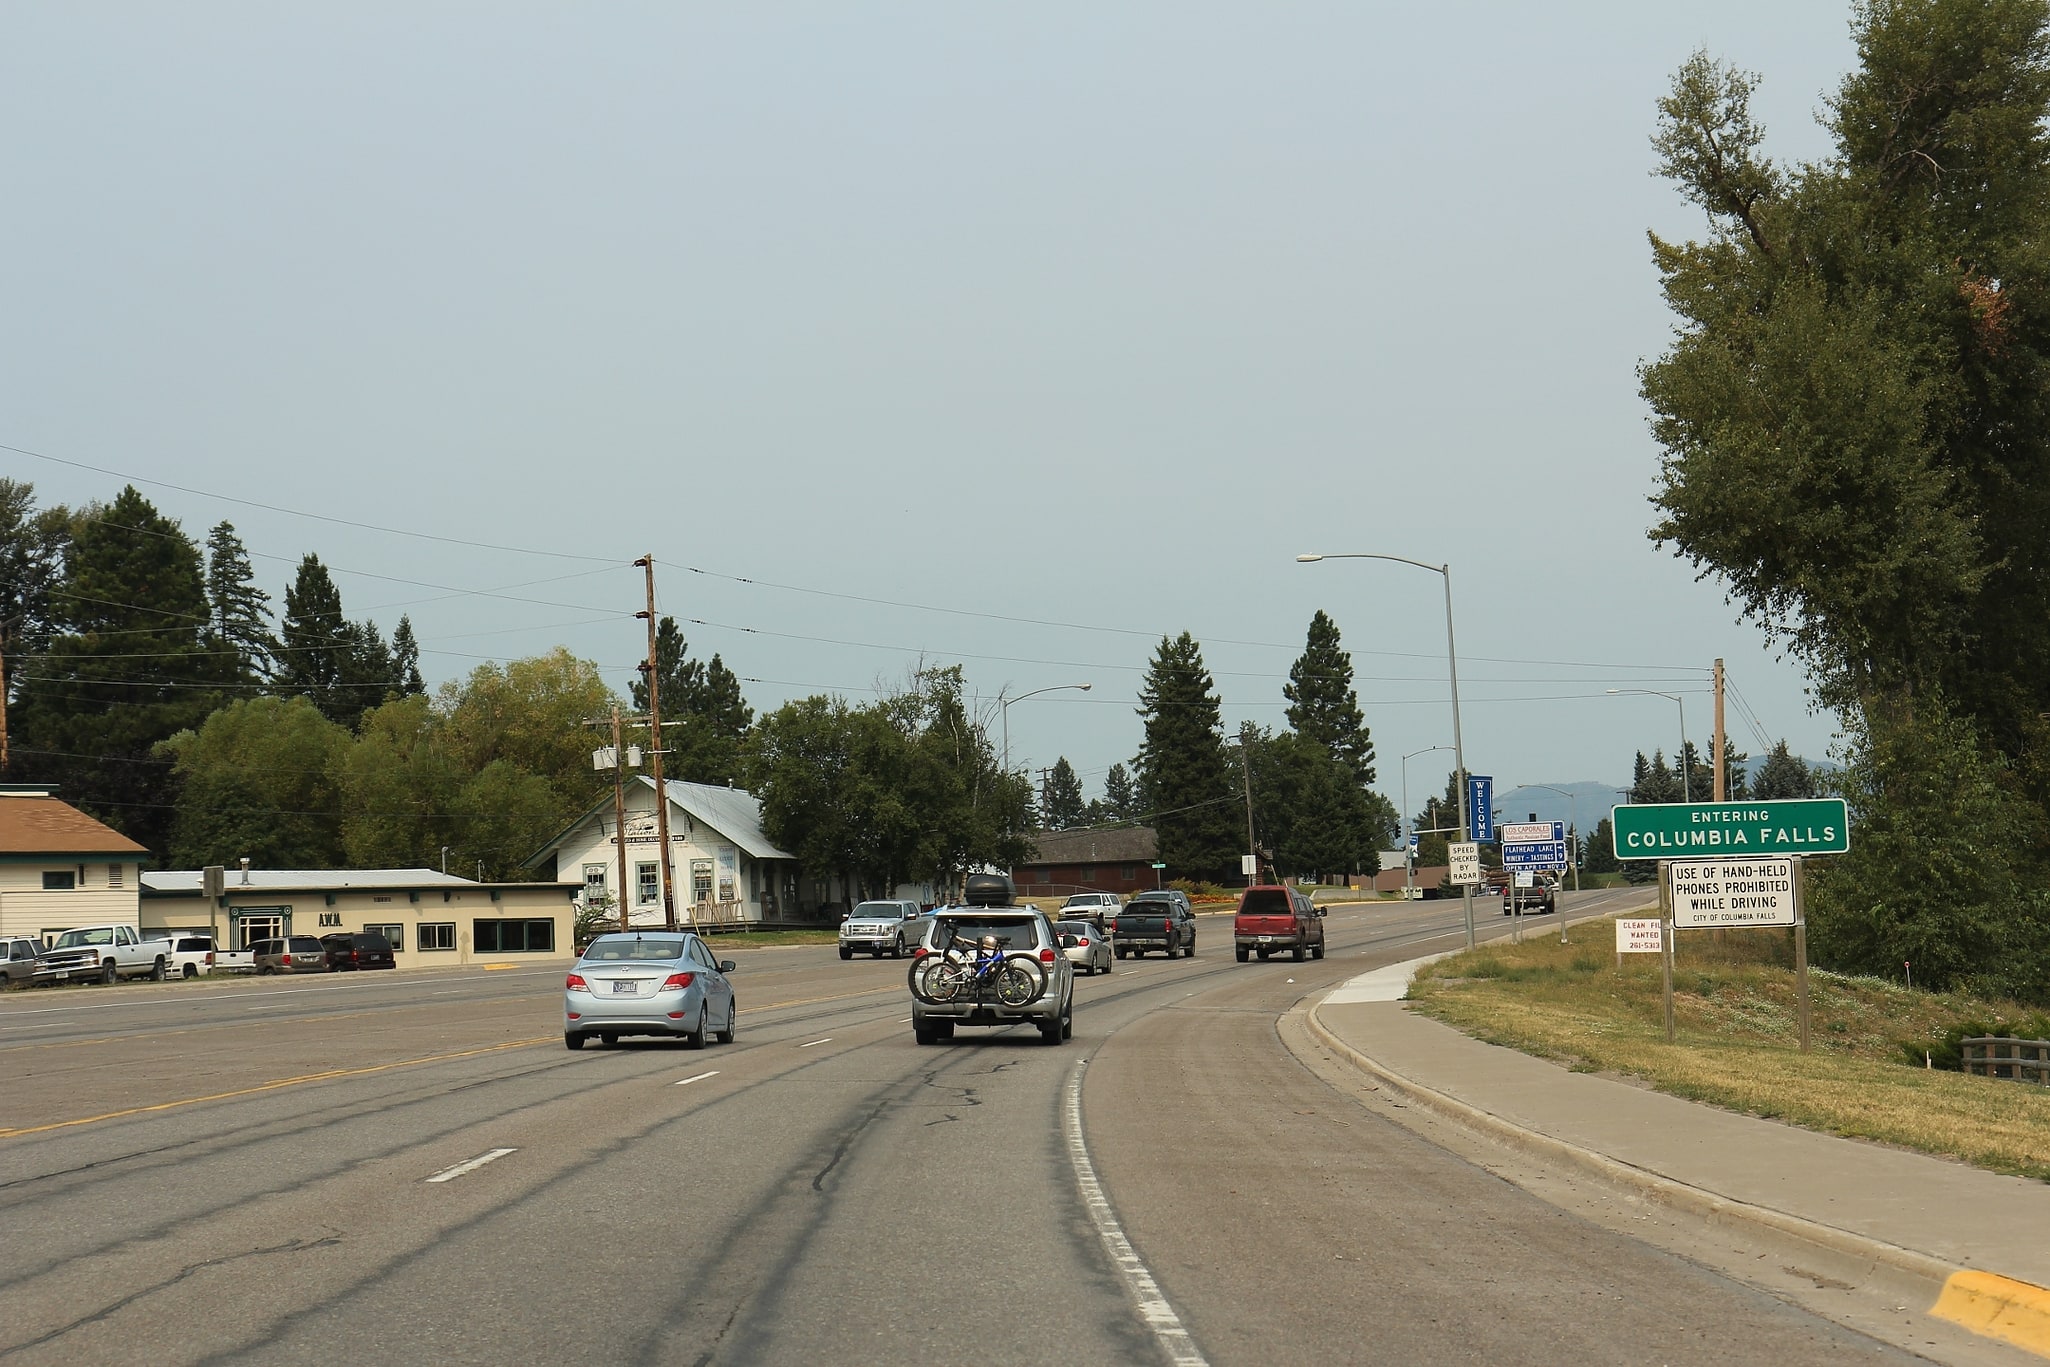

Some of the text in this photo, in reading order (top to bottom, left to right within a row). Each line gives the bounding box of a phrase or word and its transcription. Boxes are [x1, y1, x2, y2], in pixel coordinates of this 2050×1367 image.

[1476, 782, 1486, 838] WELCOME
[1692, 811, 1769, 822] ENTERING
[1506, 825, 1550, 834] LOS CAPORALES
[1628, 826, 1836, 848] COLUMBIA FALLS
[1676, 865, 1786, 879] USE OF HAND-HELD
[1676, 881, 1788, 894] PHONES PROHIBITED
[1690, 896, 1776, 910] WHILE DRIVING
